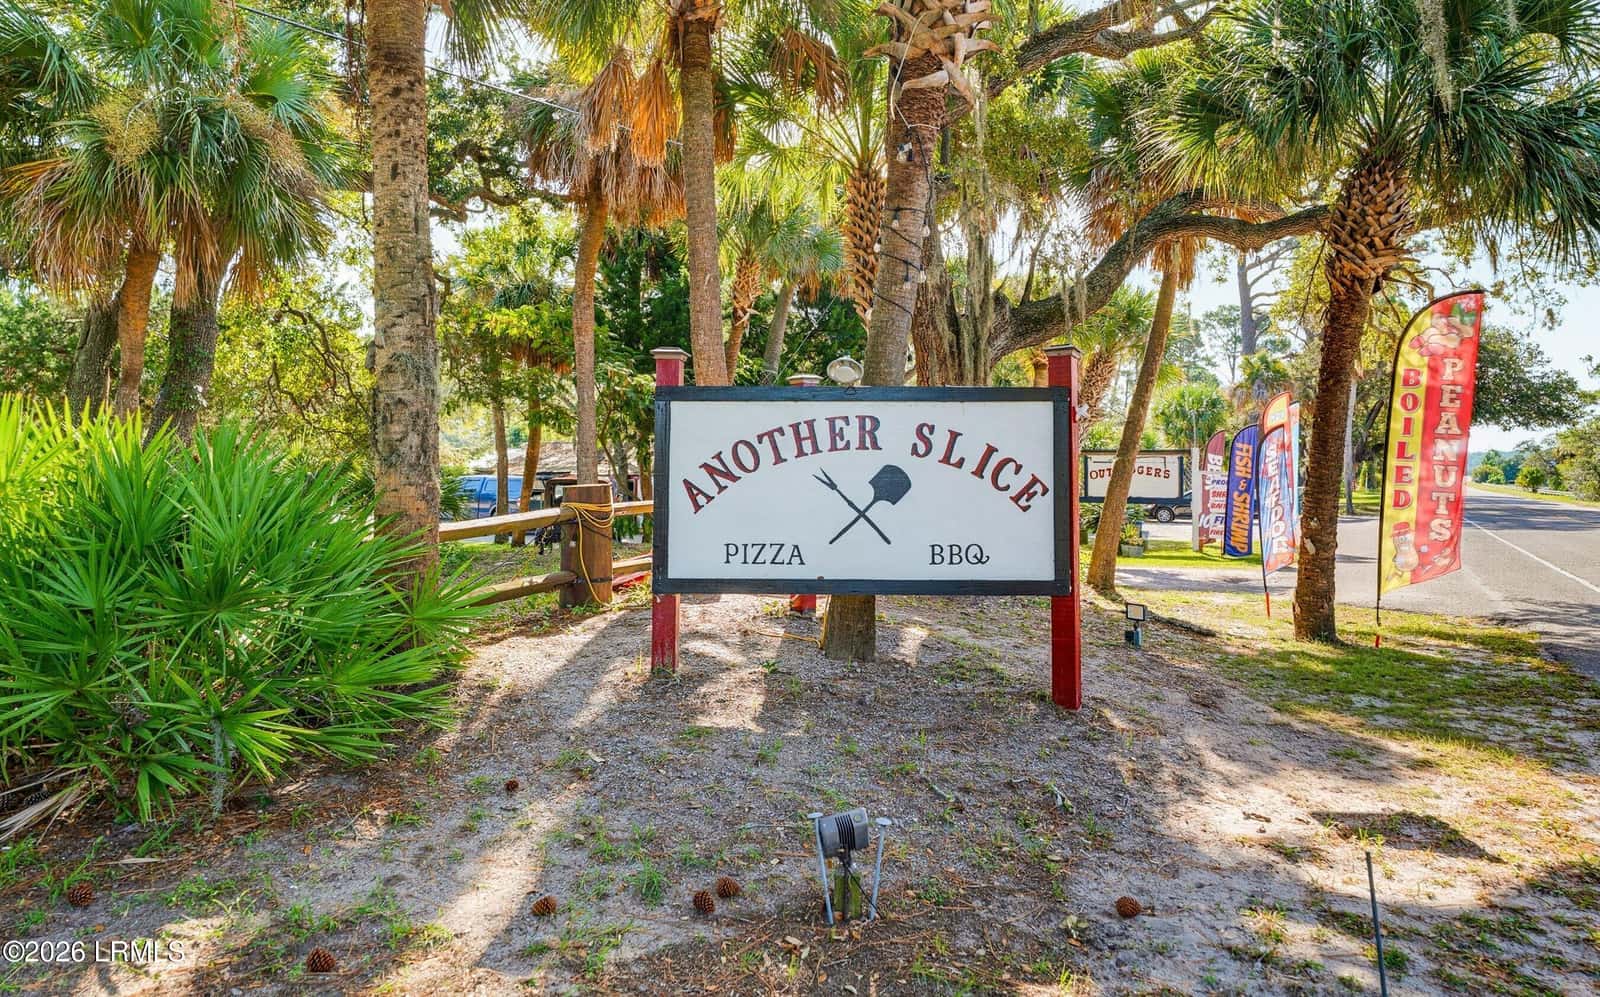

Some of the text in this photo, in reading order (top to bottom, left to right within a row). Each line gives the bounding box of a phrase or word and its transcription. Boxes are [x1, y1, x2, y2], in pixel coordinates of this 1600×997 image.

[681, 414, 1050, 515] ANOTHER SLICE
[1089, 465, 1171, 480] OUTGERS
[1392, 368, 1421, 509] BOILED
[1428, 356, 1465, 543] PEANUTS
[1231, 442, 1253, 552] FISH & SHRIMP
[724, 543, 990, 566] PIZZA BBQ
